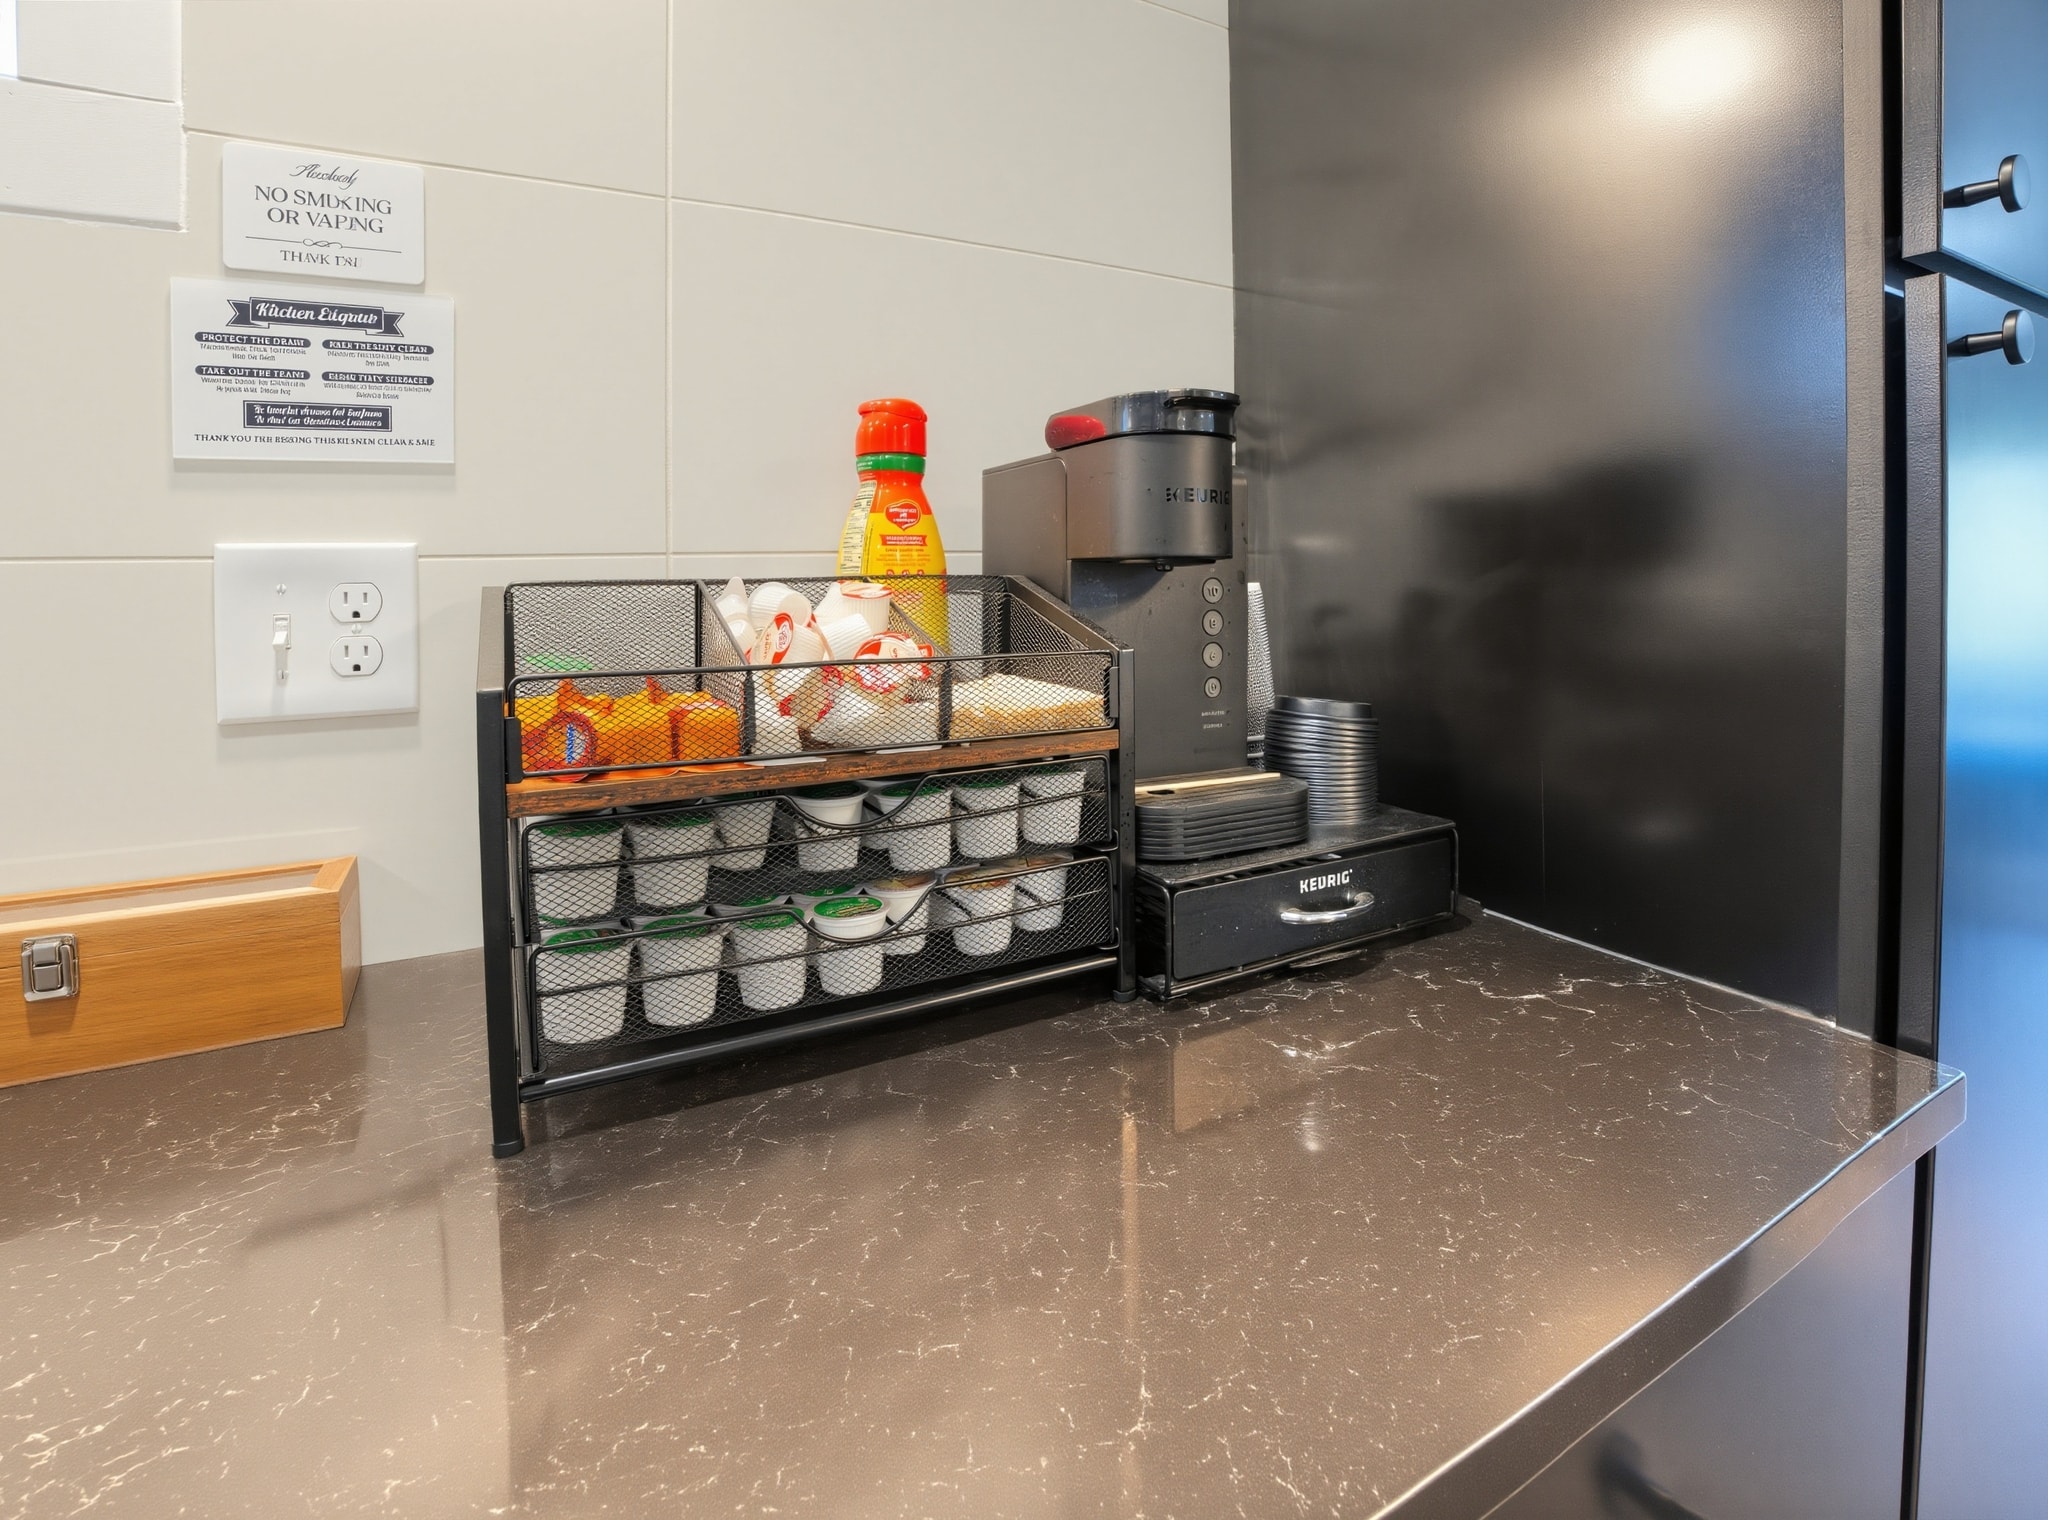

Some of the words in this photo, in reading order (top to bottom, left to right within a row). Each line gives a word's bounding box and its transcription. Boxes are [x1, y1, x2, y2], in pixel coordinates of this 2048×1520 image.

[254, 184, 289, 203] NO
[267, 207, 300, 226] OR
[250, 336, 271, 345] THE
[228, 368, 251, 377] OUT
[194, 434, 230, 443] THANK
[231, 435, 252, 444] YOU
[1299, 870, 1350, 894] KEURIG
